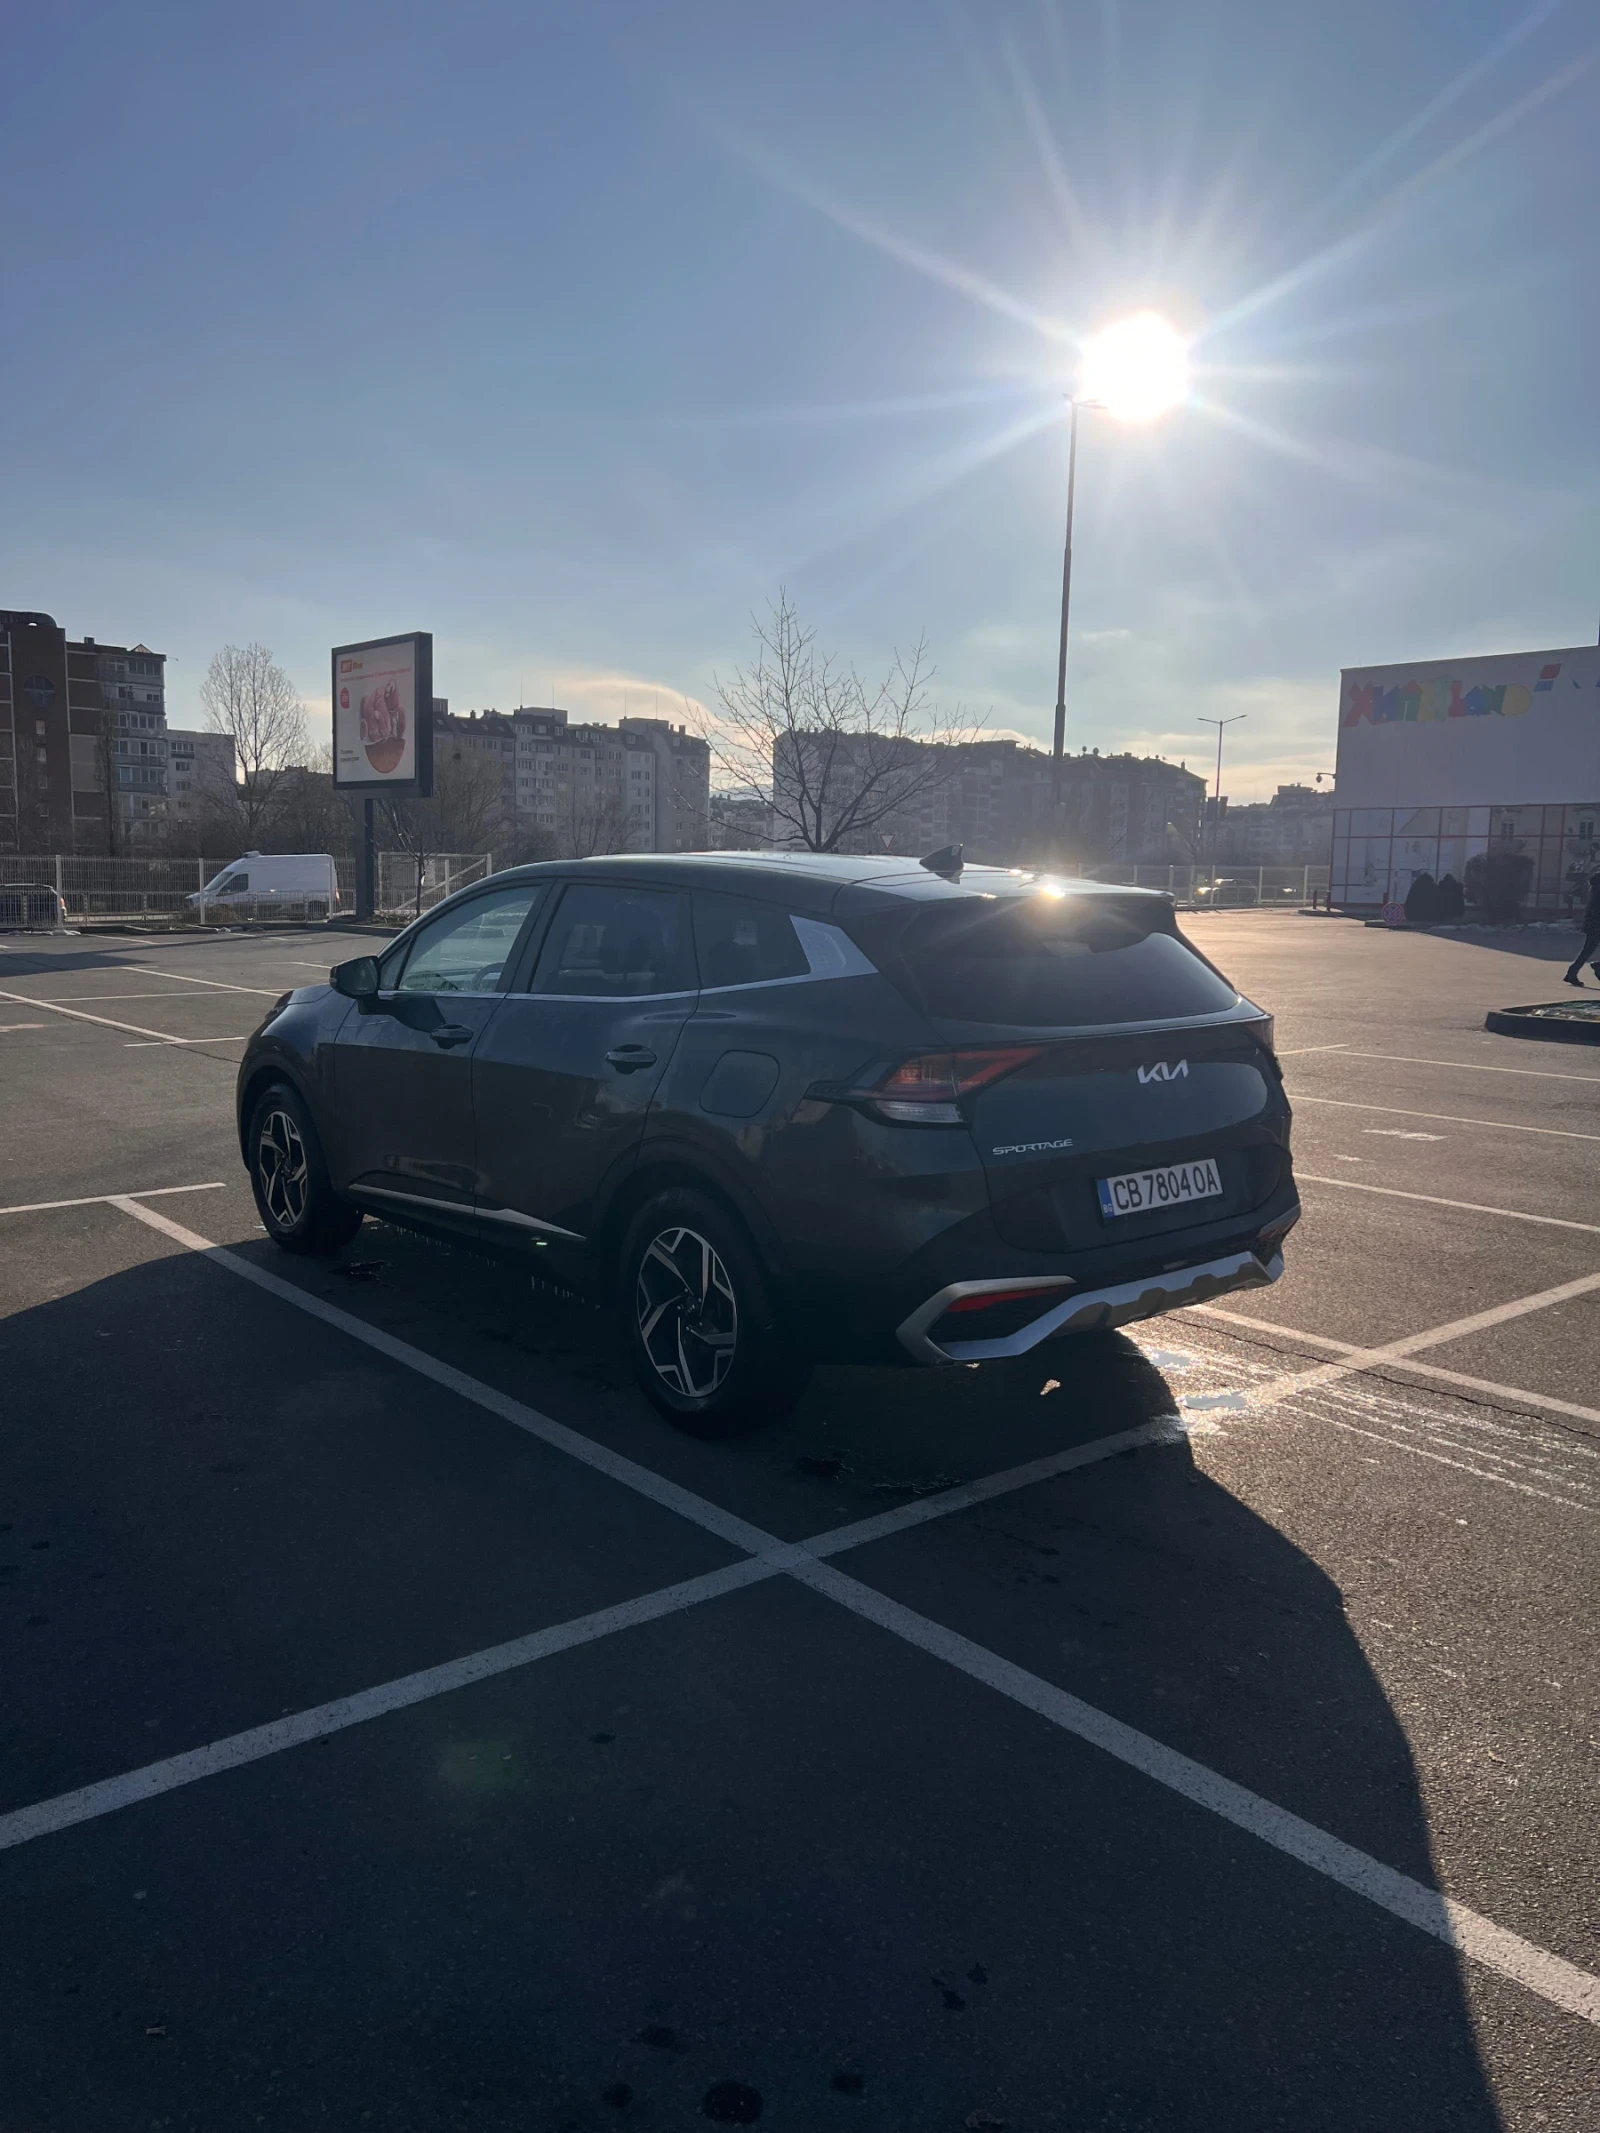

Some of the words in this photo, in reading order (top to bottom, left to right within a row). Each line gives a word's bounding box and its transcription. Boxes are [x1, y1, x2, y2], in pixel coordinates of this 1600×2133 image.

[1137, 1059, 1189, 1084] KIA
[992, 1138, 1074, 1156] SPORTAGE
[1103, 1203, 1113, 1213] BG
